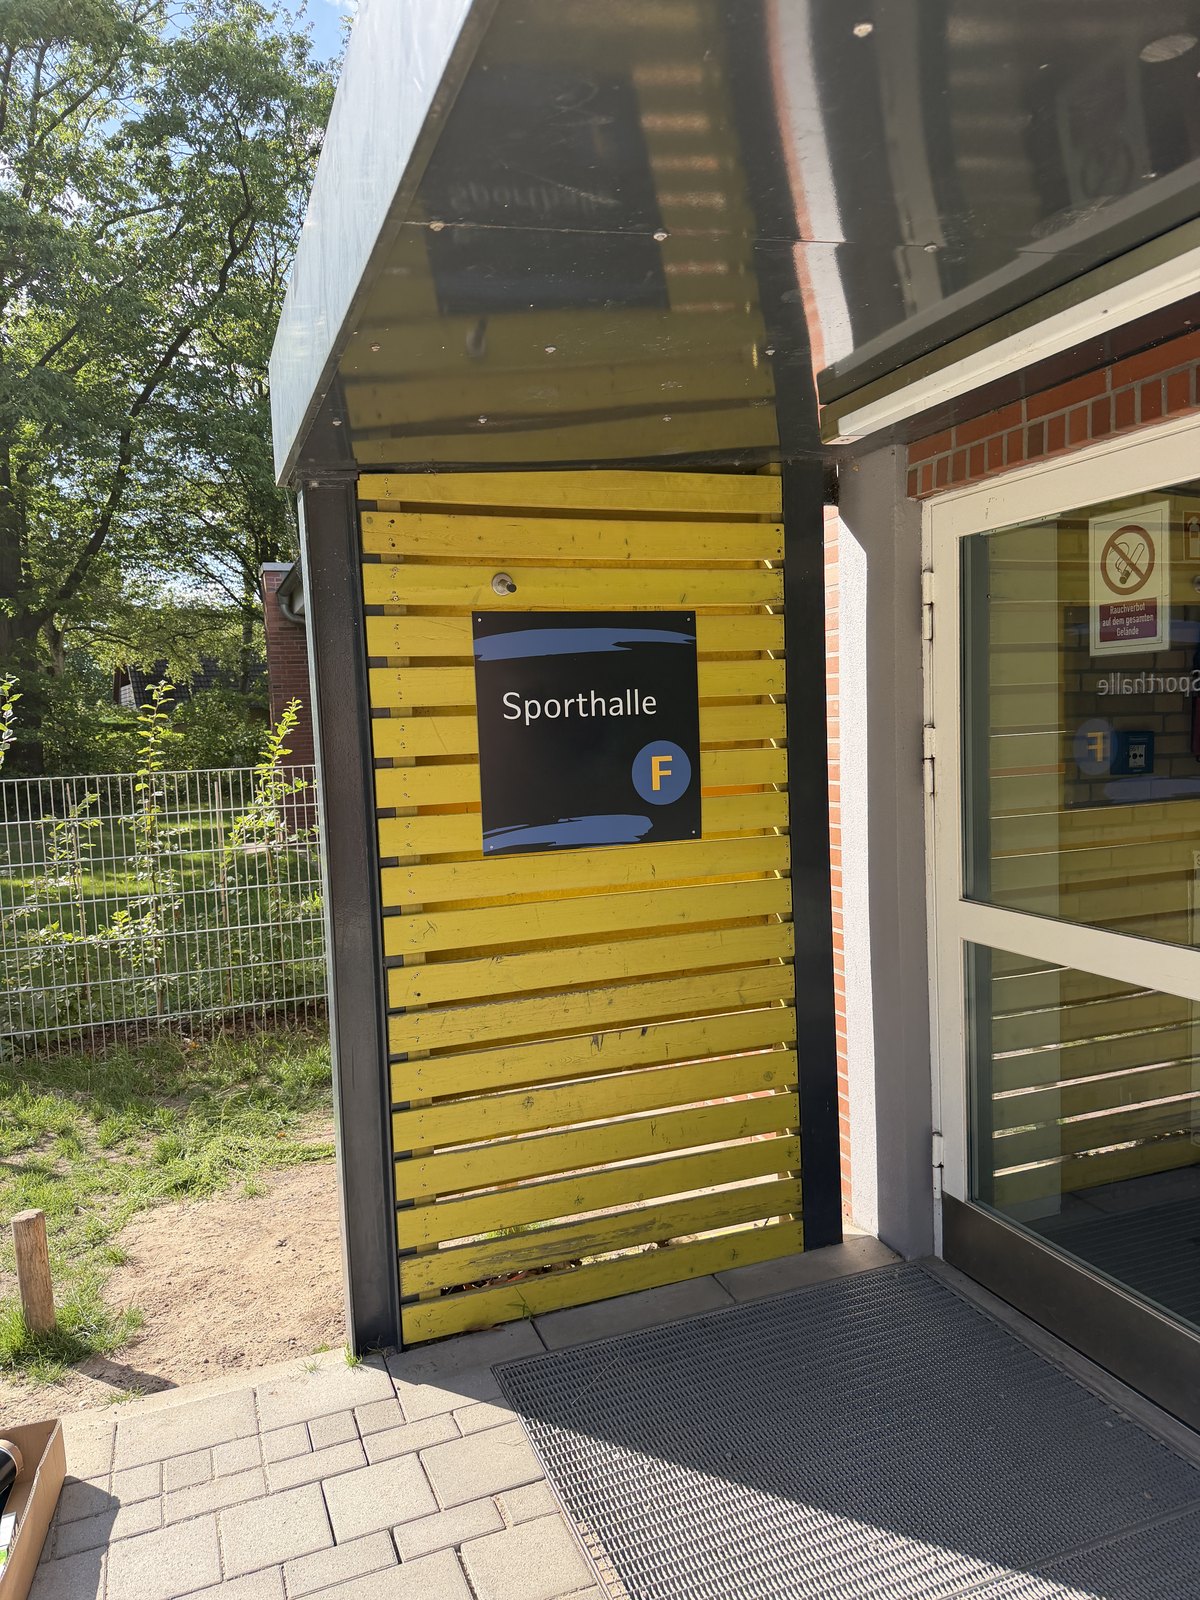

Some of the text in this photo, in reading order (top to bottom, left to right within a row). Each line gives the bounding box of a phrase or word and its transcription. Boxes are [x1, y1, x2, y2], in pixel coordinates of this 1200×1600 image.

[1110, 602, 1146, 615] Rauchverbot
[1102, 614, 1154, 627] auf dem gesamten
[1116, 626, 1139, 637] Gelände
[502, 688, 657, 726] Sporthalle
[651, 755, 673, 791] F
